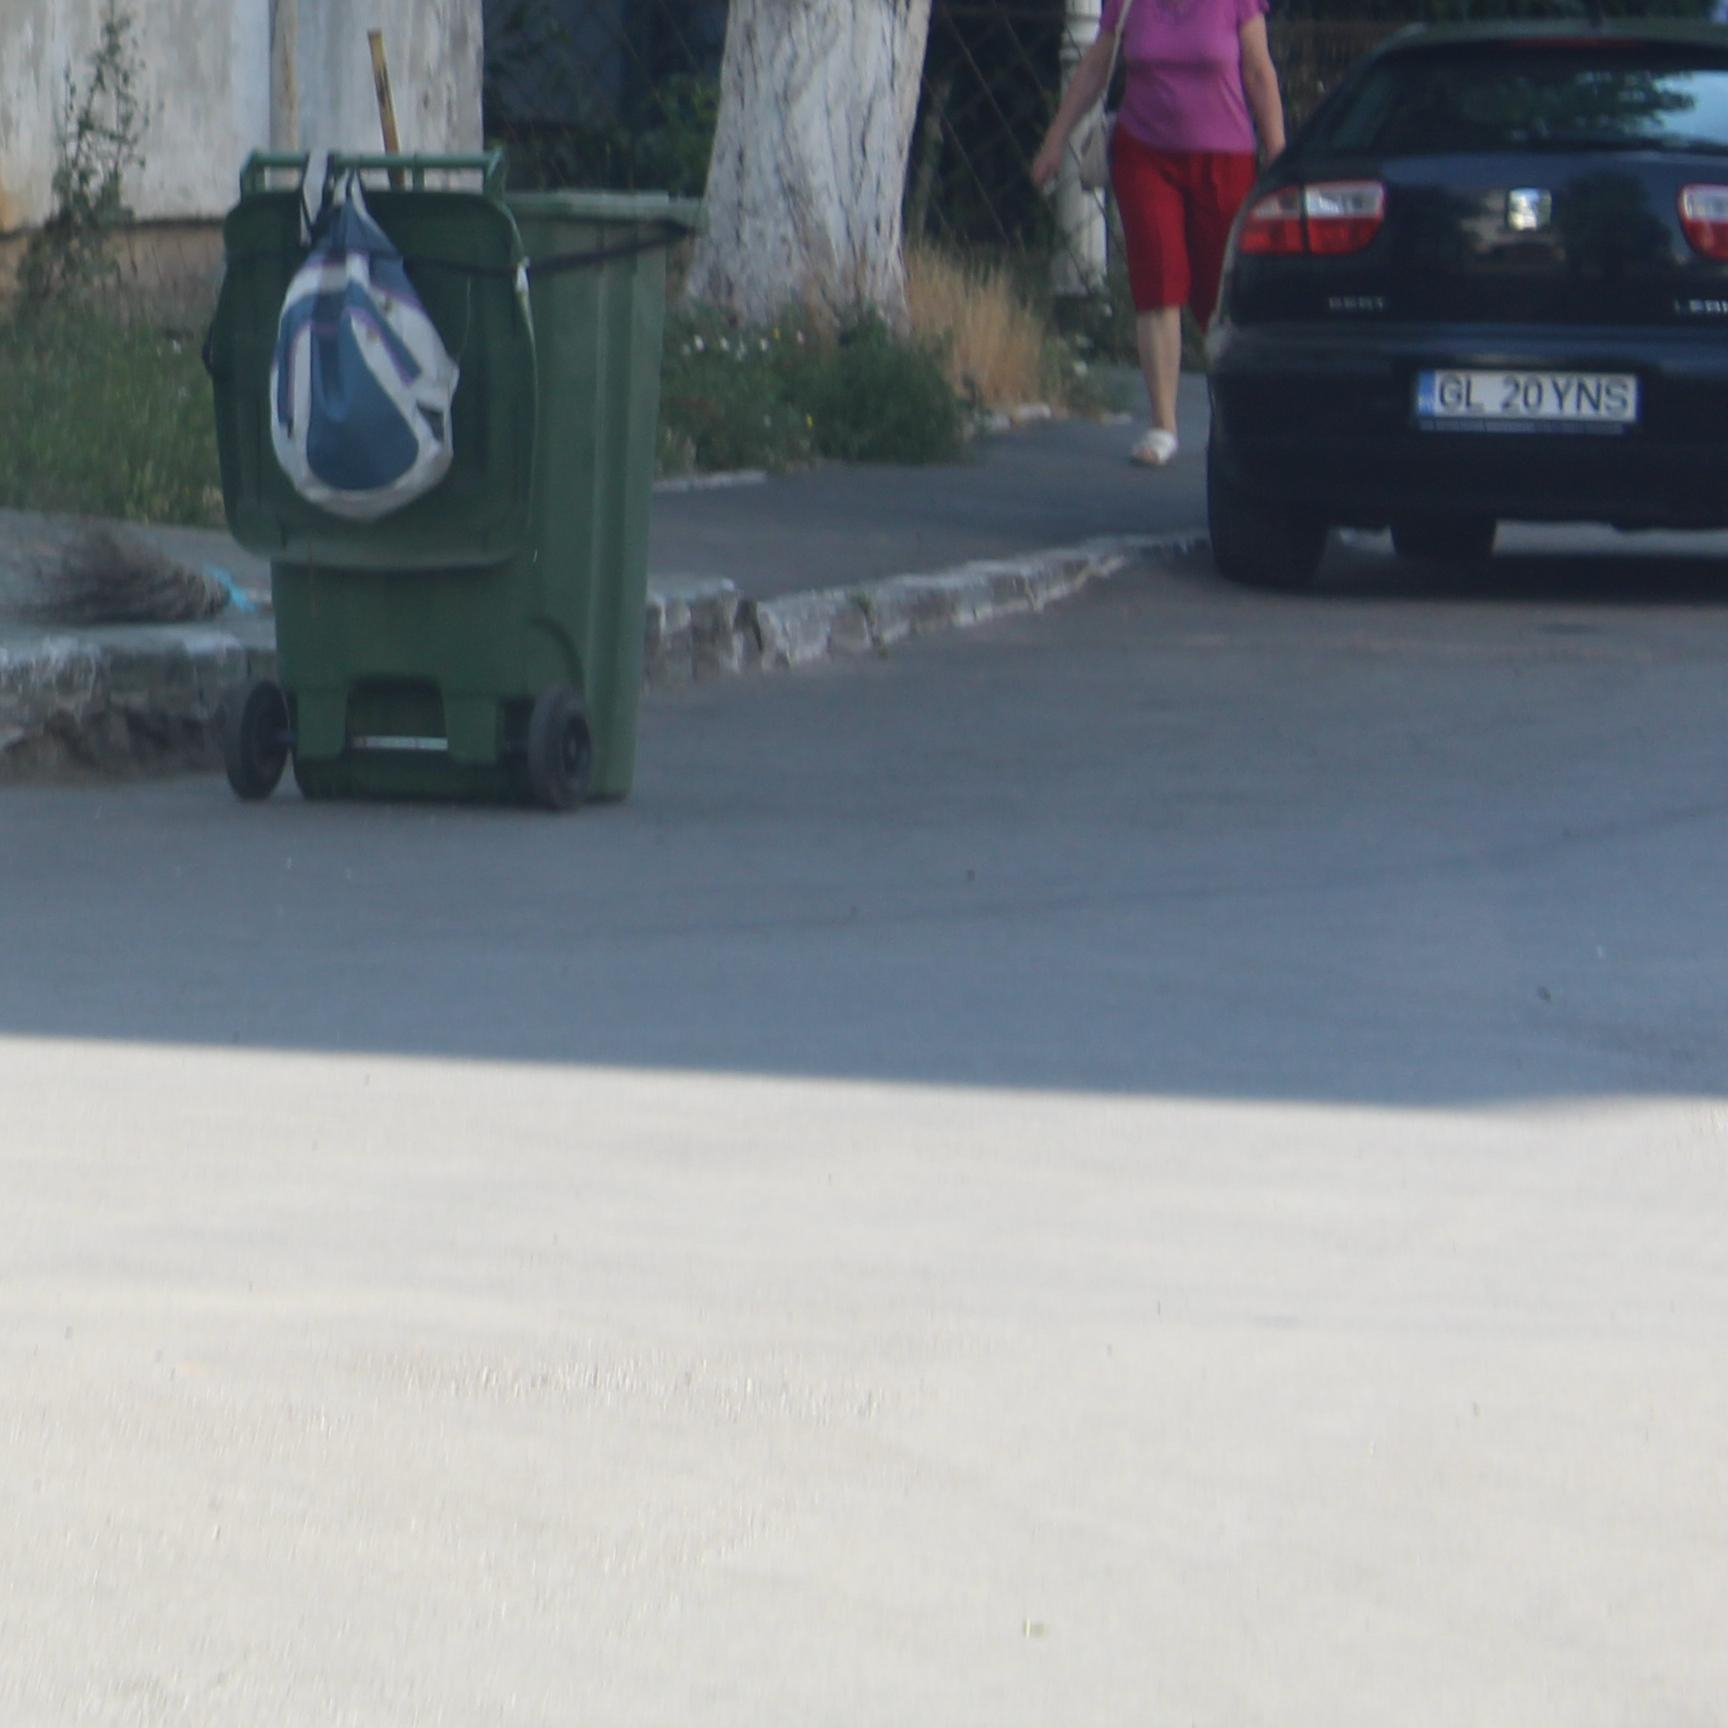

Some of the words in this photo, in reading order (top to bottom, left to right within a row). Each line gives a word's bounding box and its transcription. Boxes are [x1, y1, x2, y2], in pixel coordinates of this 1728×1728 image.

[1439, 372, 1485, 413] GL
[1500, 373, 1543, 414] 20
[1550, 373, 1629, 417] YNS
